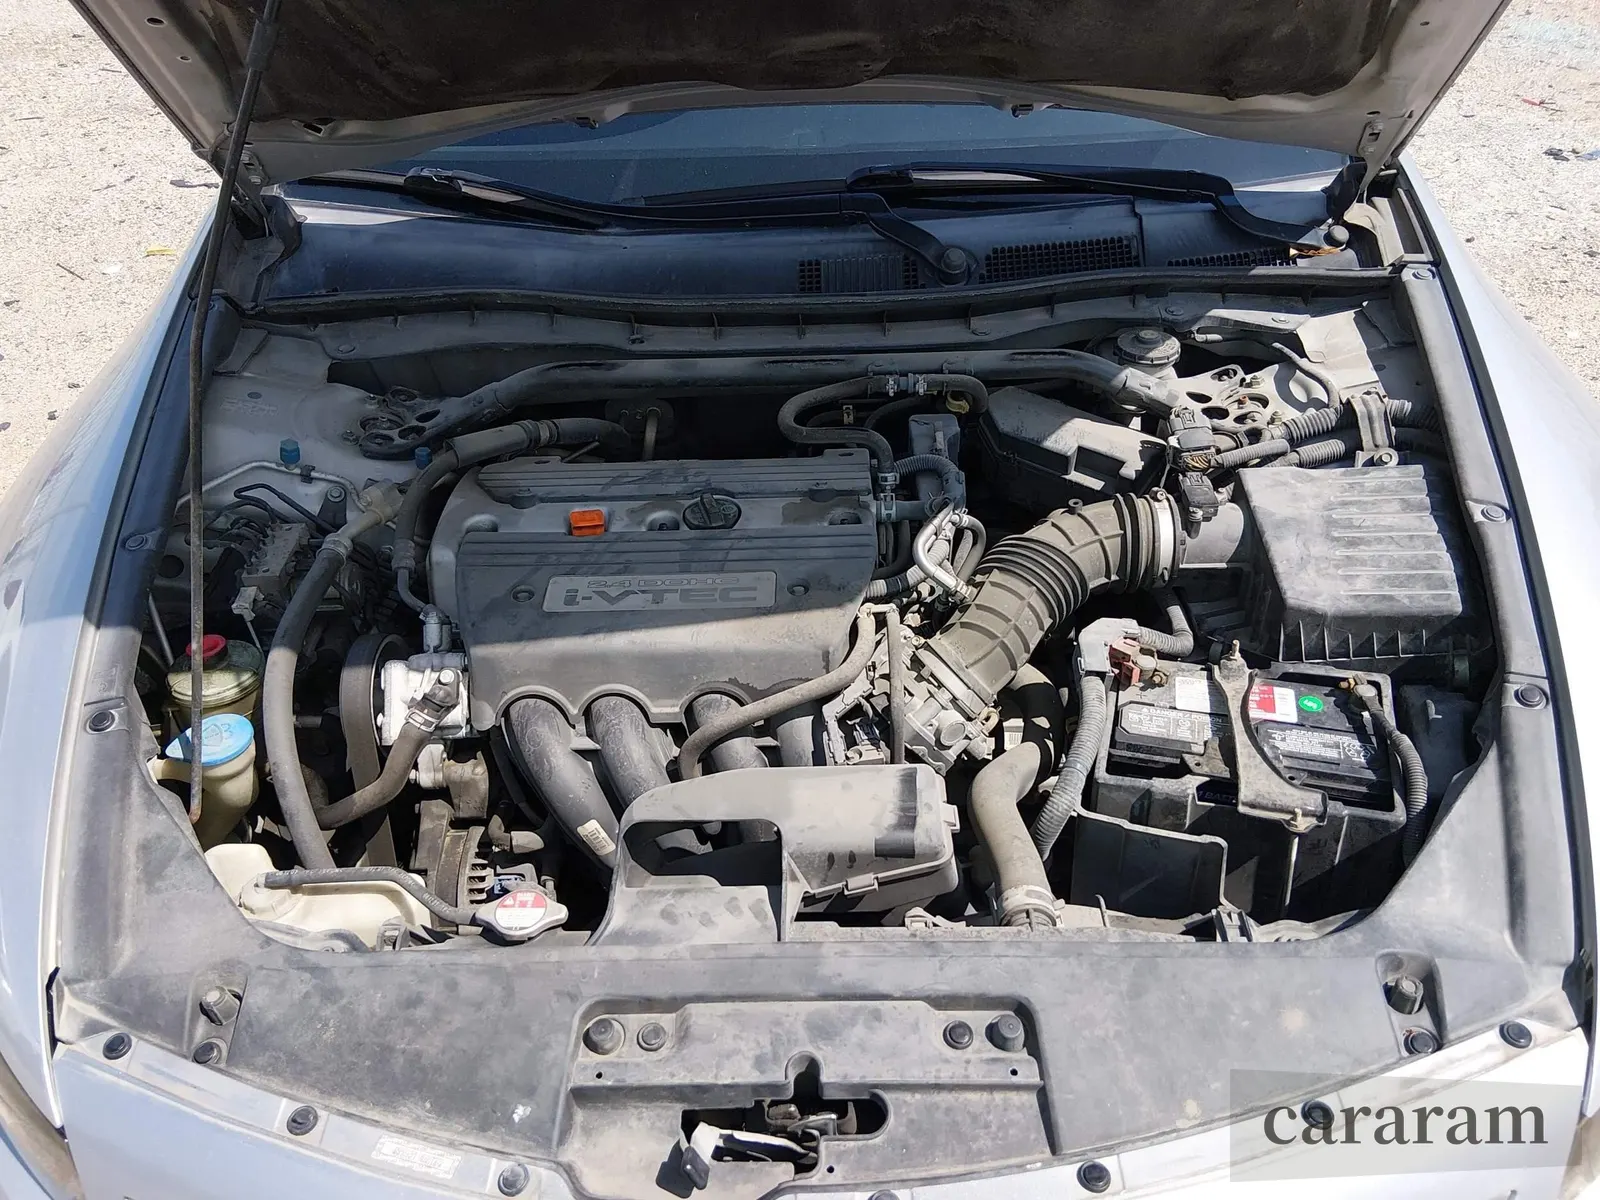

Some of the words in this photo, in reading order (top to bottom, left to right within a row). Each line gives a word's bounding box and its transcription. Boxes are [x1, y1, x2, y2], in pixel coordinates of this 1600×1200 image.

[587, 579, 632, 589] 2.4
[638, 577, 740, 587] DOHC
[564, 587, 756, 606] i-VTEC
